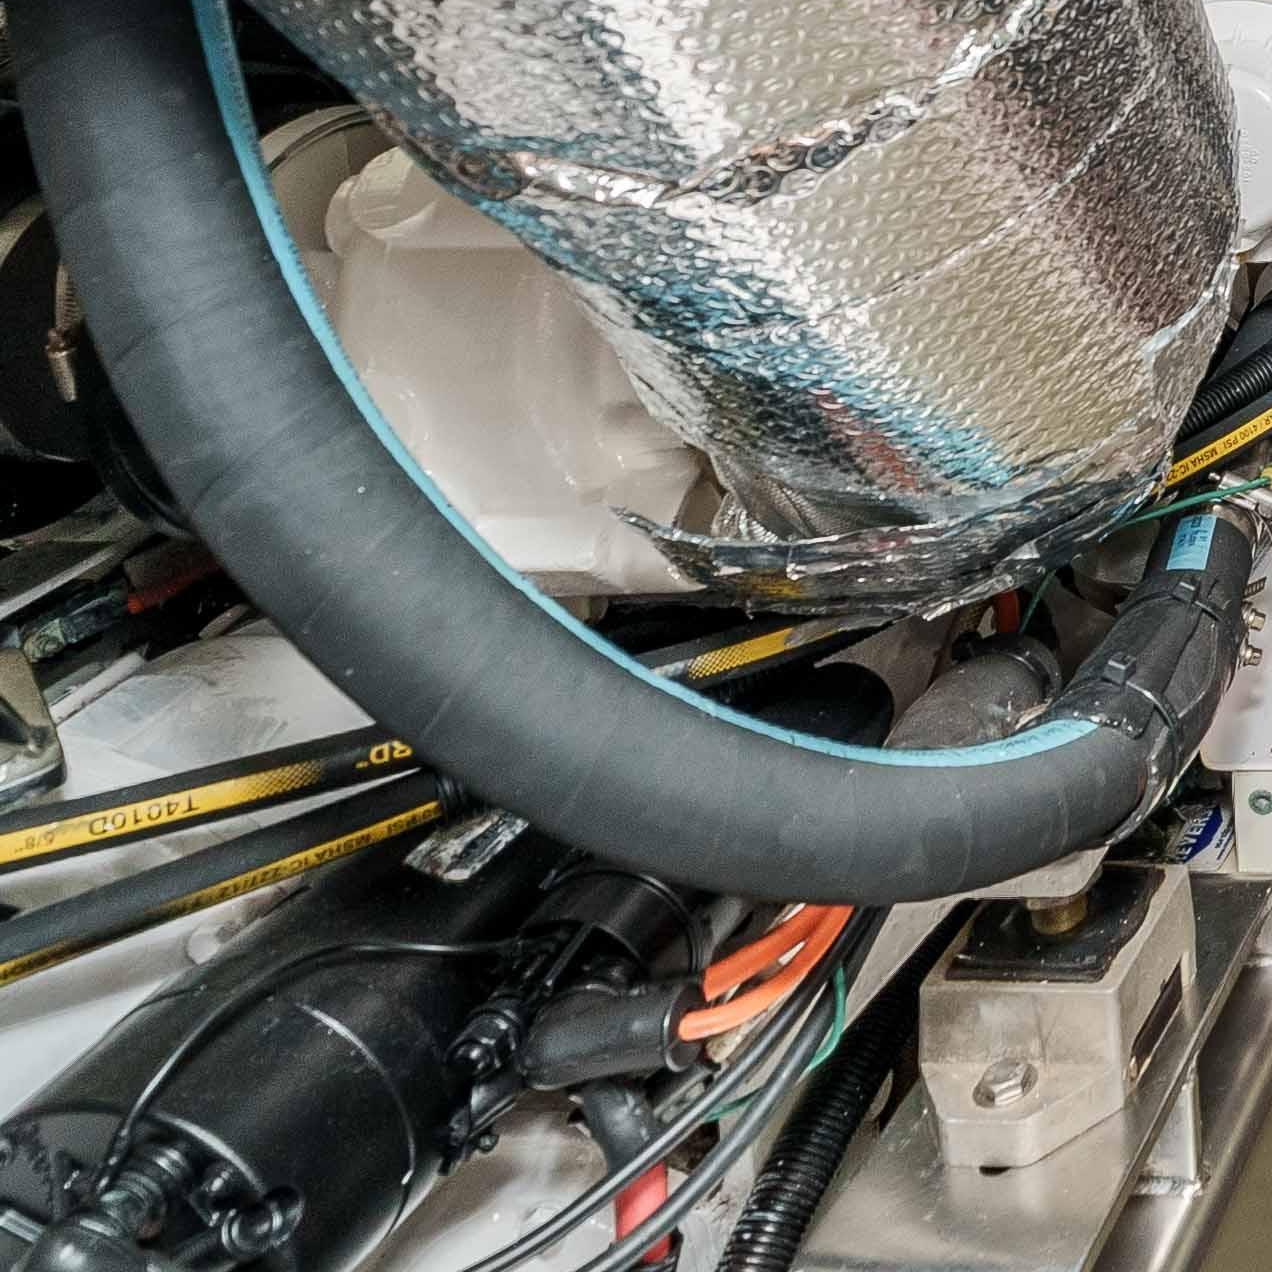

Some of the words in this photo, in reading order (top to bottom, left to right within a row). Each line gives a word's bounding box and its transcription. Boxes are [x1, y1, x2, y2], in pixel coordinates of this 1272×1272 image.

[1223, 437, 1239, 449] PSI
[1190, 447, 1218, 465] MSHA
[88, 794, 200, 836] T4010D
